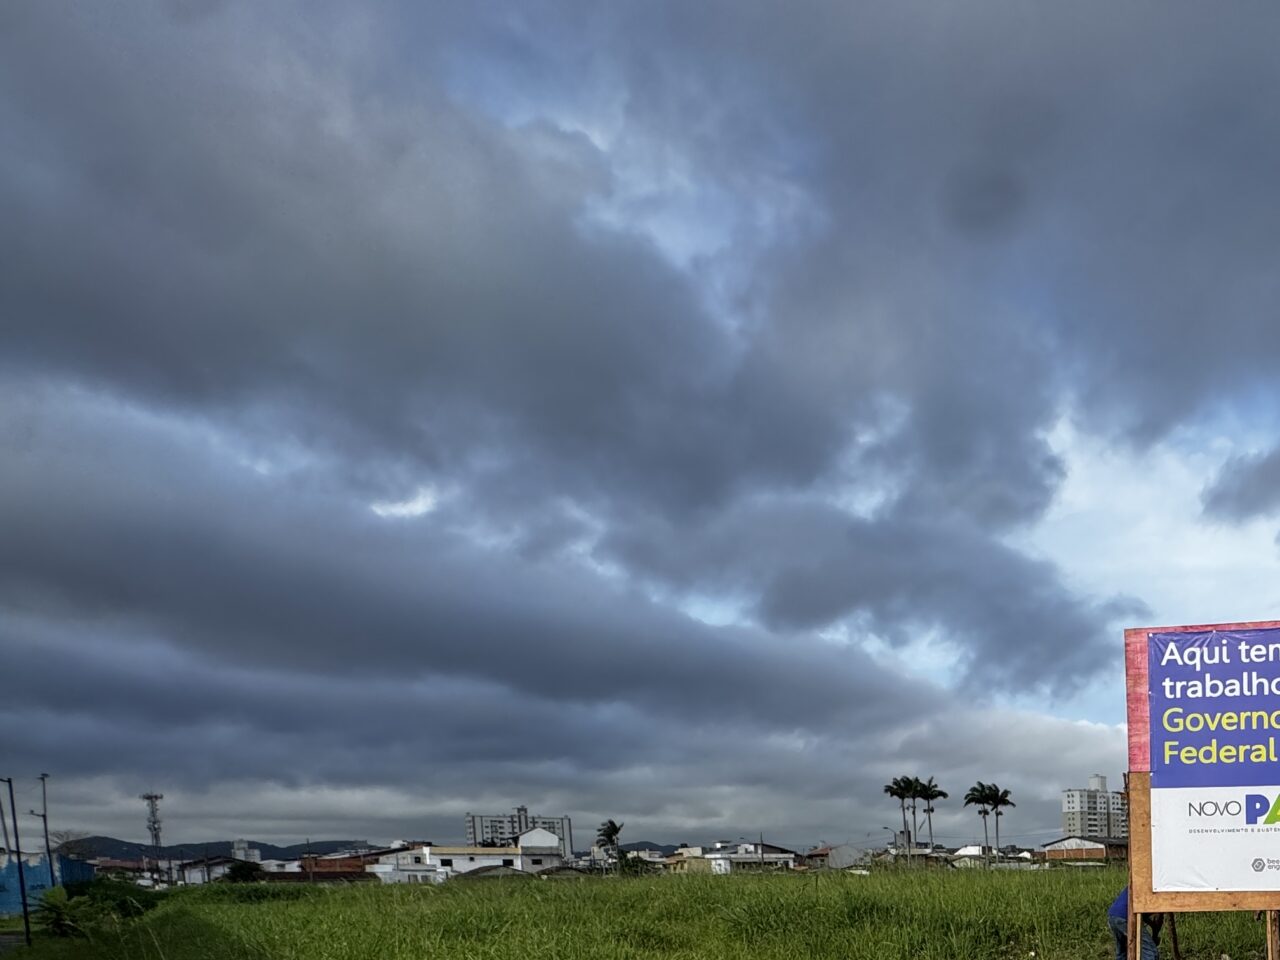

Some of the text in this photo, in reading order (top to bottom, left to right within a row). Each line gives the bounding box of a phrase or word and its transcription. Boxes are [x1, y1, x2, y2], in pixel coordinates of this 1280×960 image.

[1160, 639, 1230, 671] Aqui
[1164, 737, 1278, 765] Federal
[1188, 800, 1242, 817] NOVO
